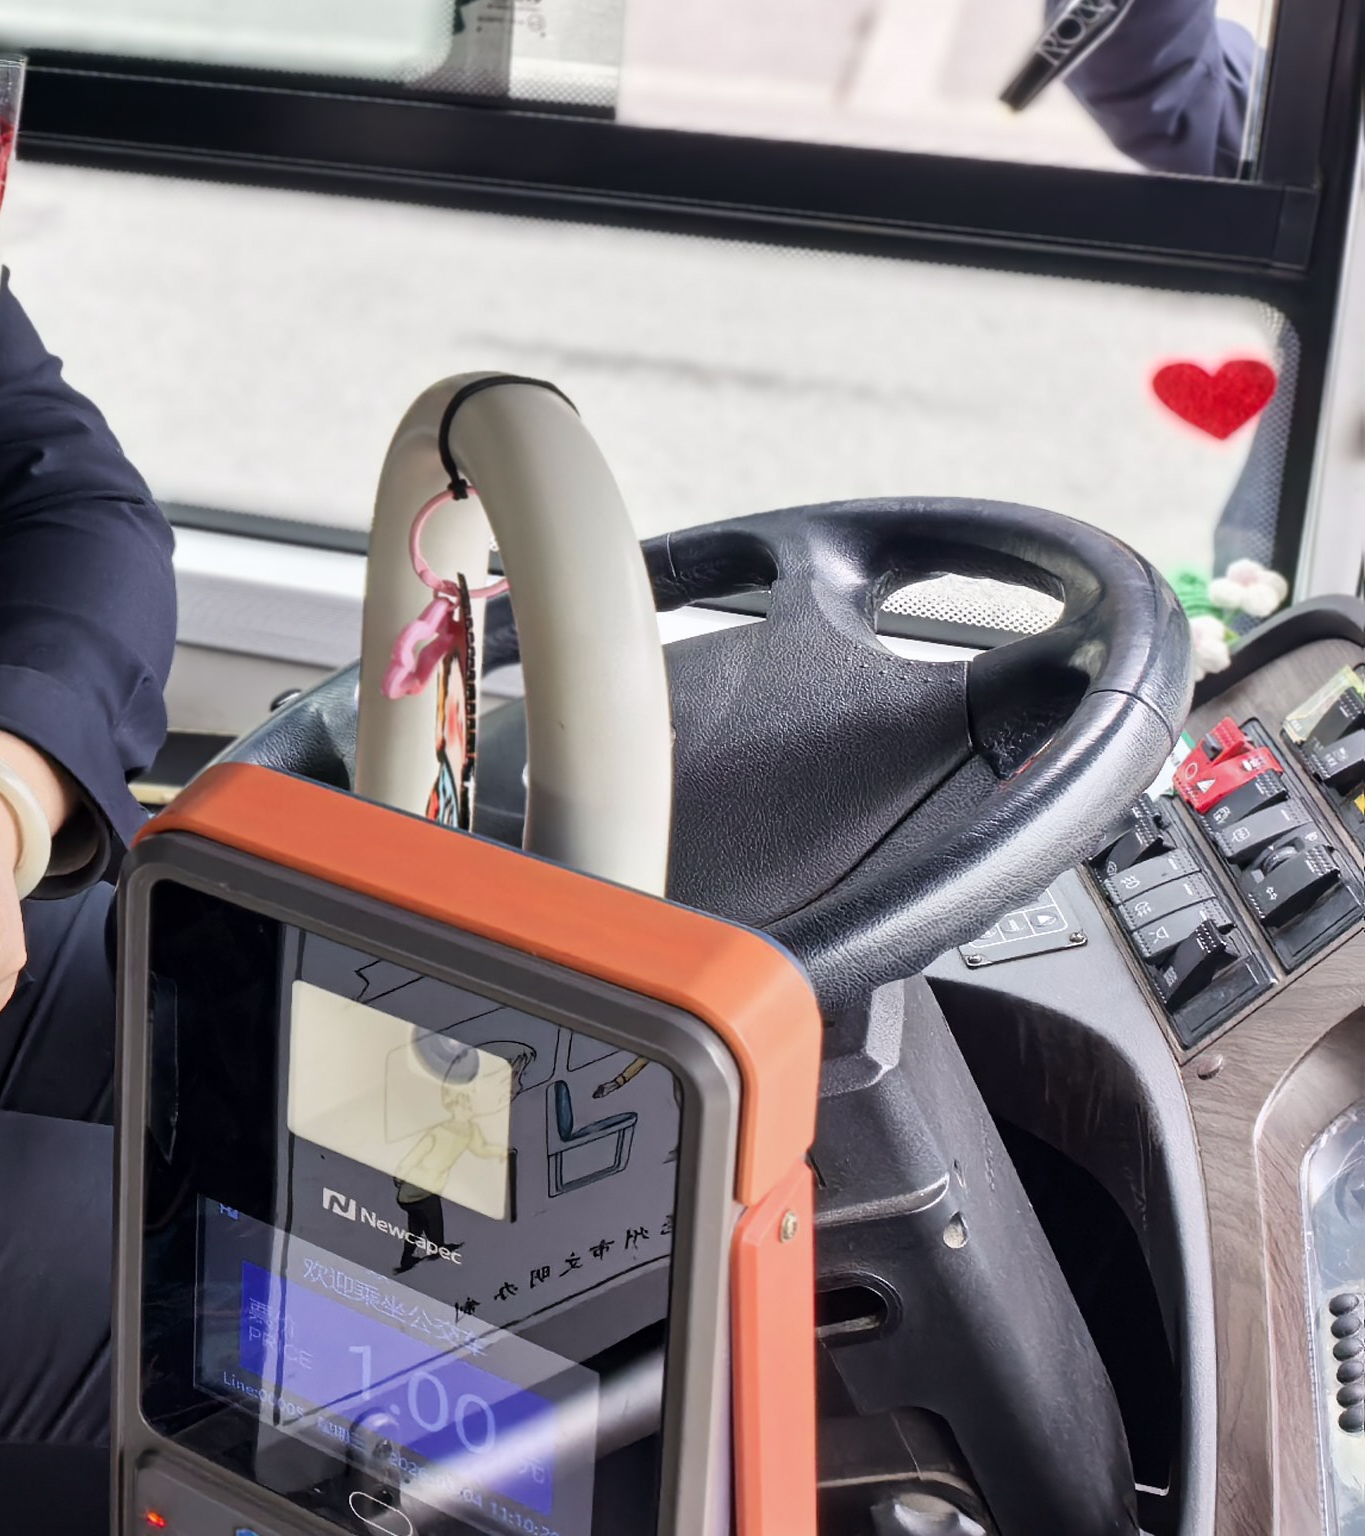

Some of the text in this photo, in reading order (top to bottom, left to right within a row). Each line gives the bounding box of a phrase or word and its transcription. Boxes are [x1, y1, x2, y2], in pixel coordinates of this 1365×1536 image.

[360, 1206, 462, 1265] Newcapec
[248, 1326, 314, 1370] PRCE
[348, 1344, 496, 1456] 1.00
